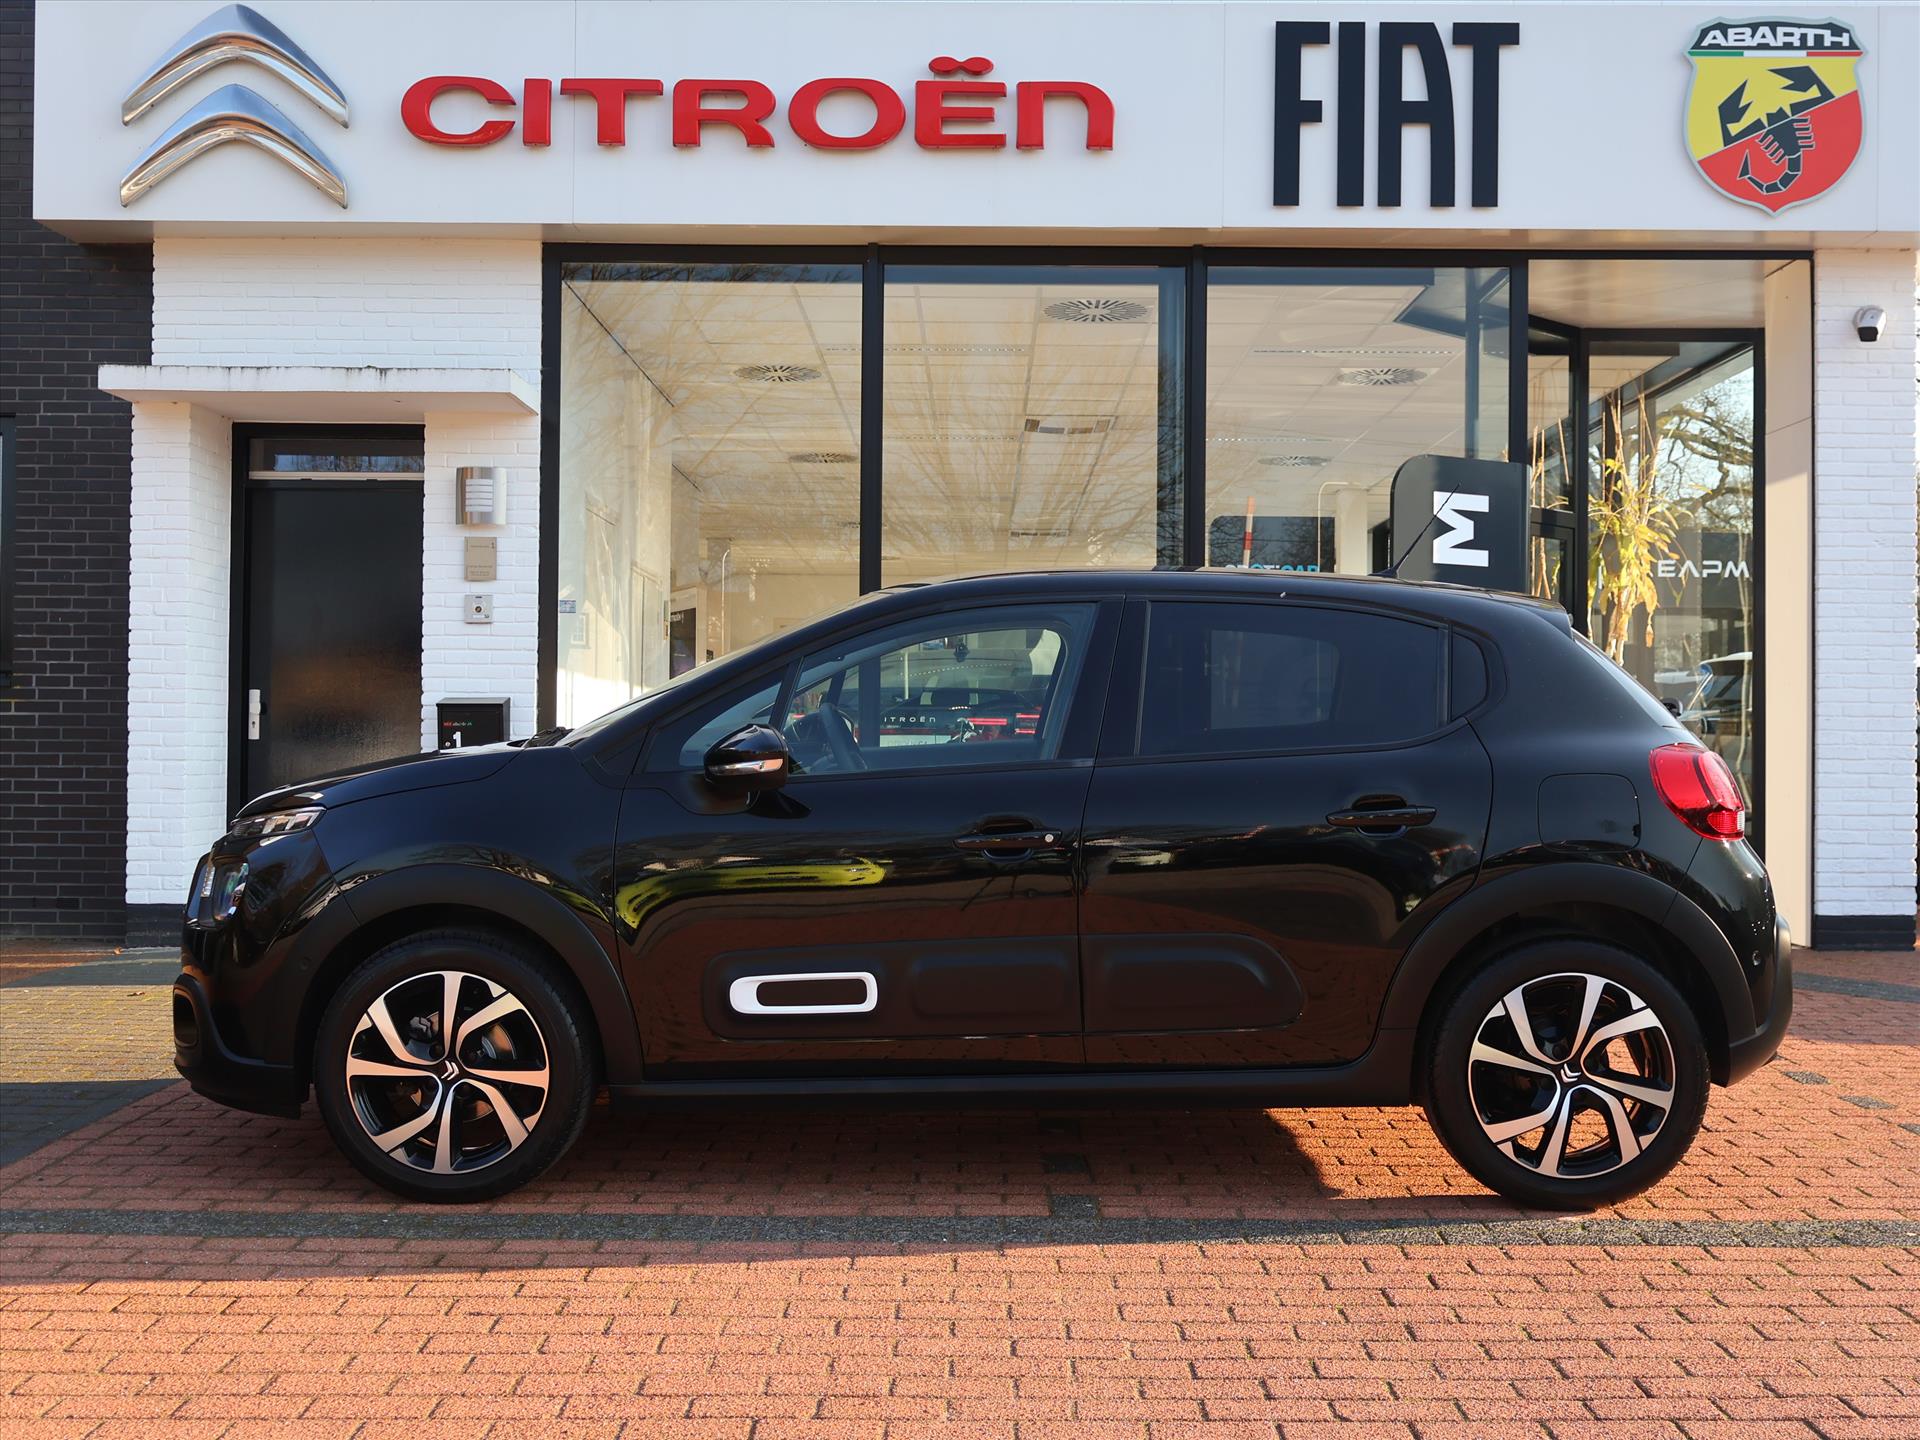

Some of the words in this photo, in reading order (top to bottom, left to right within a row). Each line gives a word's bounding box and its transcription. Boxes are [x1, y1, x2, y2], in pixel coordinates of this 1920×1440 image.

[1700, 26, 1850, 47] ABARTH
[401, 55, 1116, 151] CITROËN
[1273, 20, 1520, 208] FIAT
[1656, 559, 1750, 578] EAPM
[452, 731, 462, 748] 1
